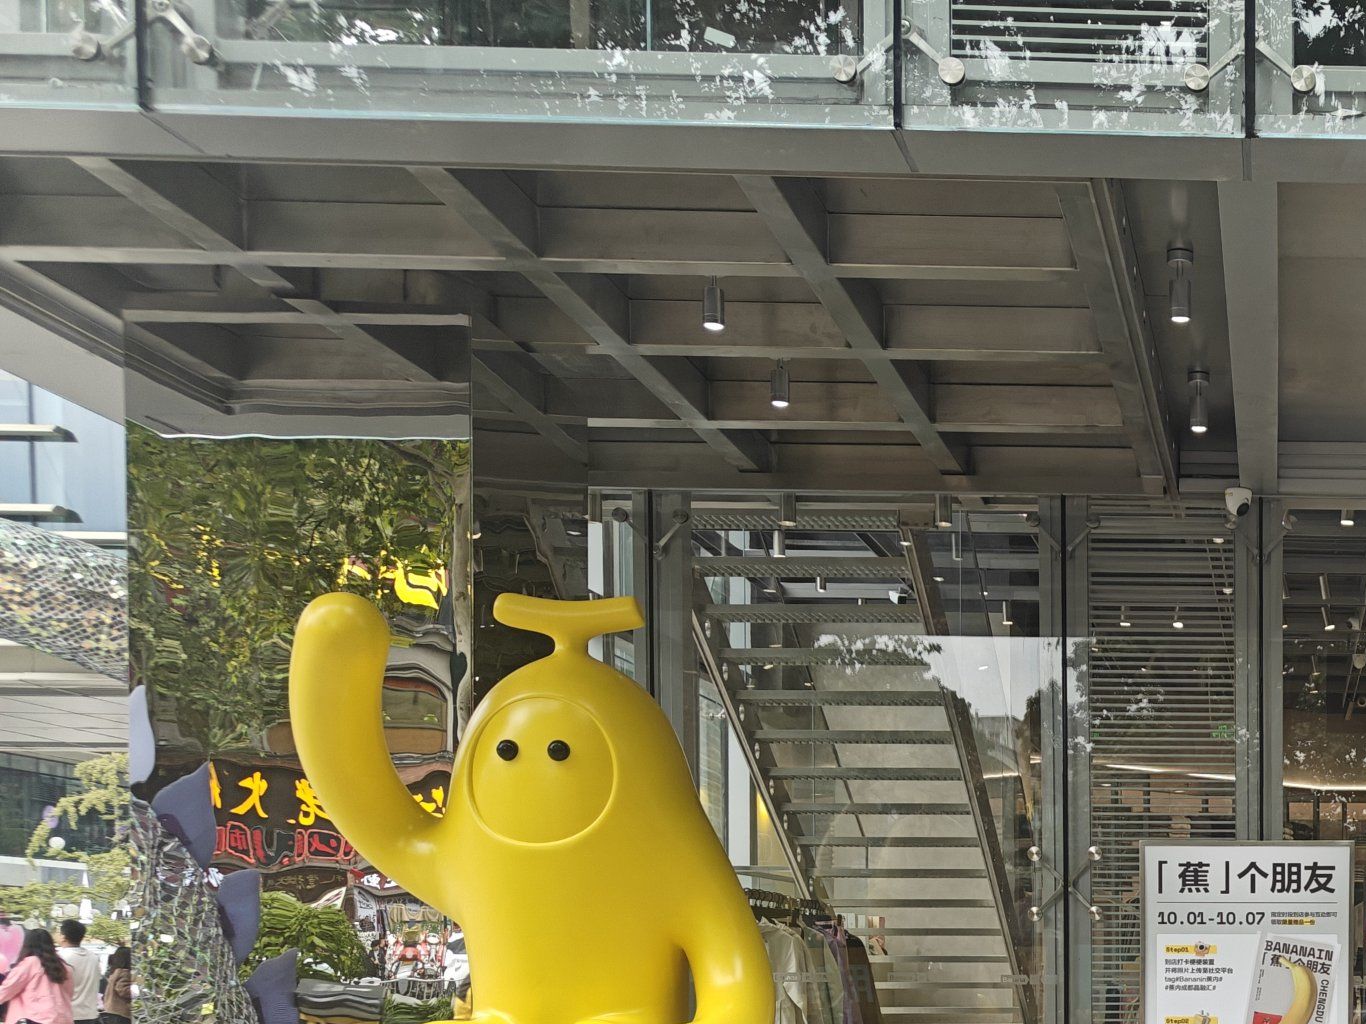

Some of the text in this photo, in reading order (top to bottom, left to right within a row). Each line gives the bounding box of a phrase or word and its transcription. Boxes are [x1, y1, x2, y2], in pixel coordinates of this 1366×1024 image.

[1157, 861, 1336, 894] 「蕉」个朋友
[1157, 911, 1265, 925] 10.01-10.07
[1264, 940, 1334, 962] BANANAIN
[1315, 979, 1330, 1023] CHENGDU
